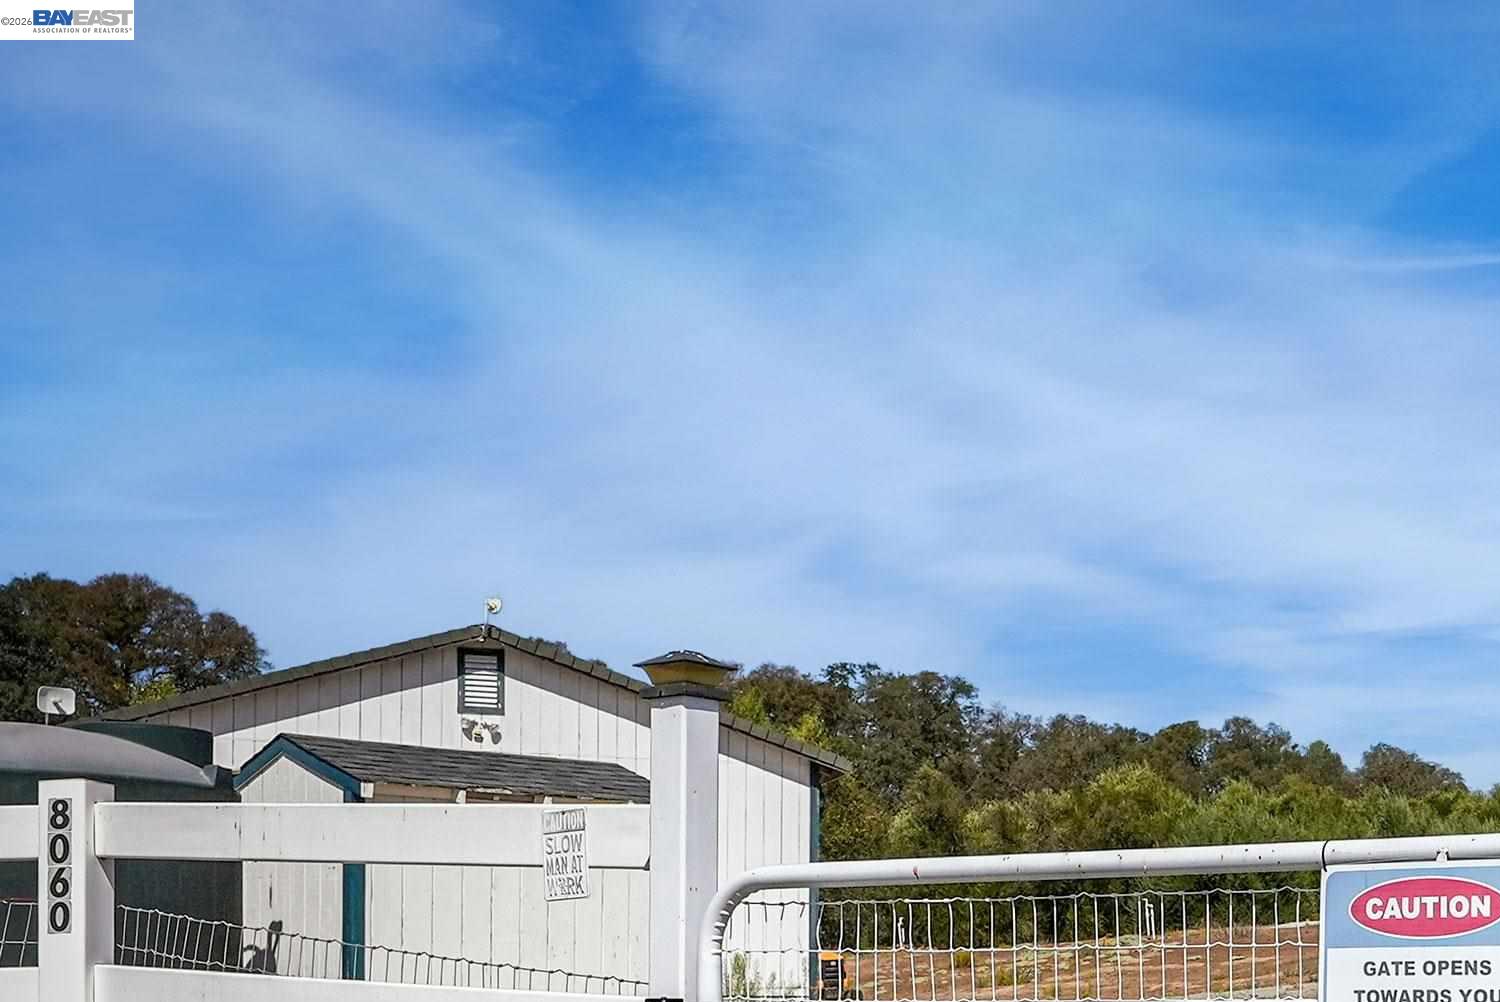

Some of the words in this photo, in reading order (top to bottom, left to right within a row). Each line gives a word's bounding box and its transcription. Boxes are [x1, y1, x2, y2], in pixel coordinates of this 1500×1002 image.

[545, 833, 583, 855] SLOW
[49, 799, 70, 932] 8060
[545, 855, 568, 877] MAN
[571, 855, 584, 874] AT
[1366, 896, 1491, 920] CAUTION
[1363, 960, 1416, 976] GATE
[1423, 960, 1492, 976] OPENS
